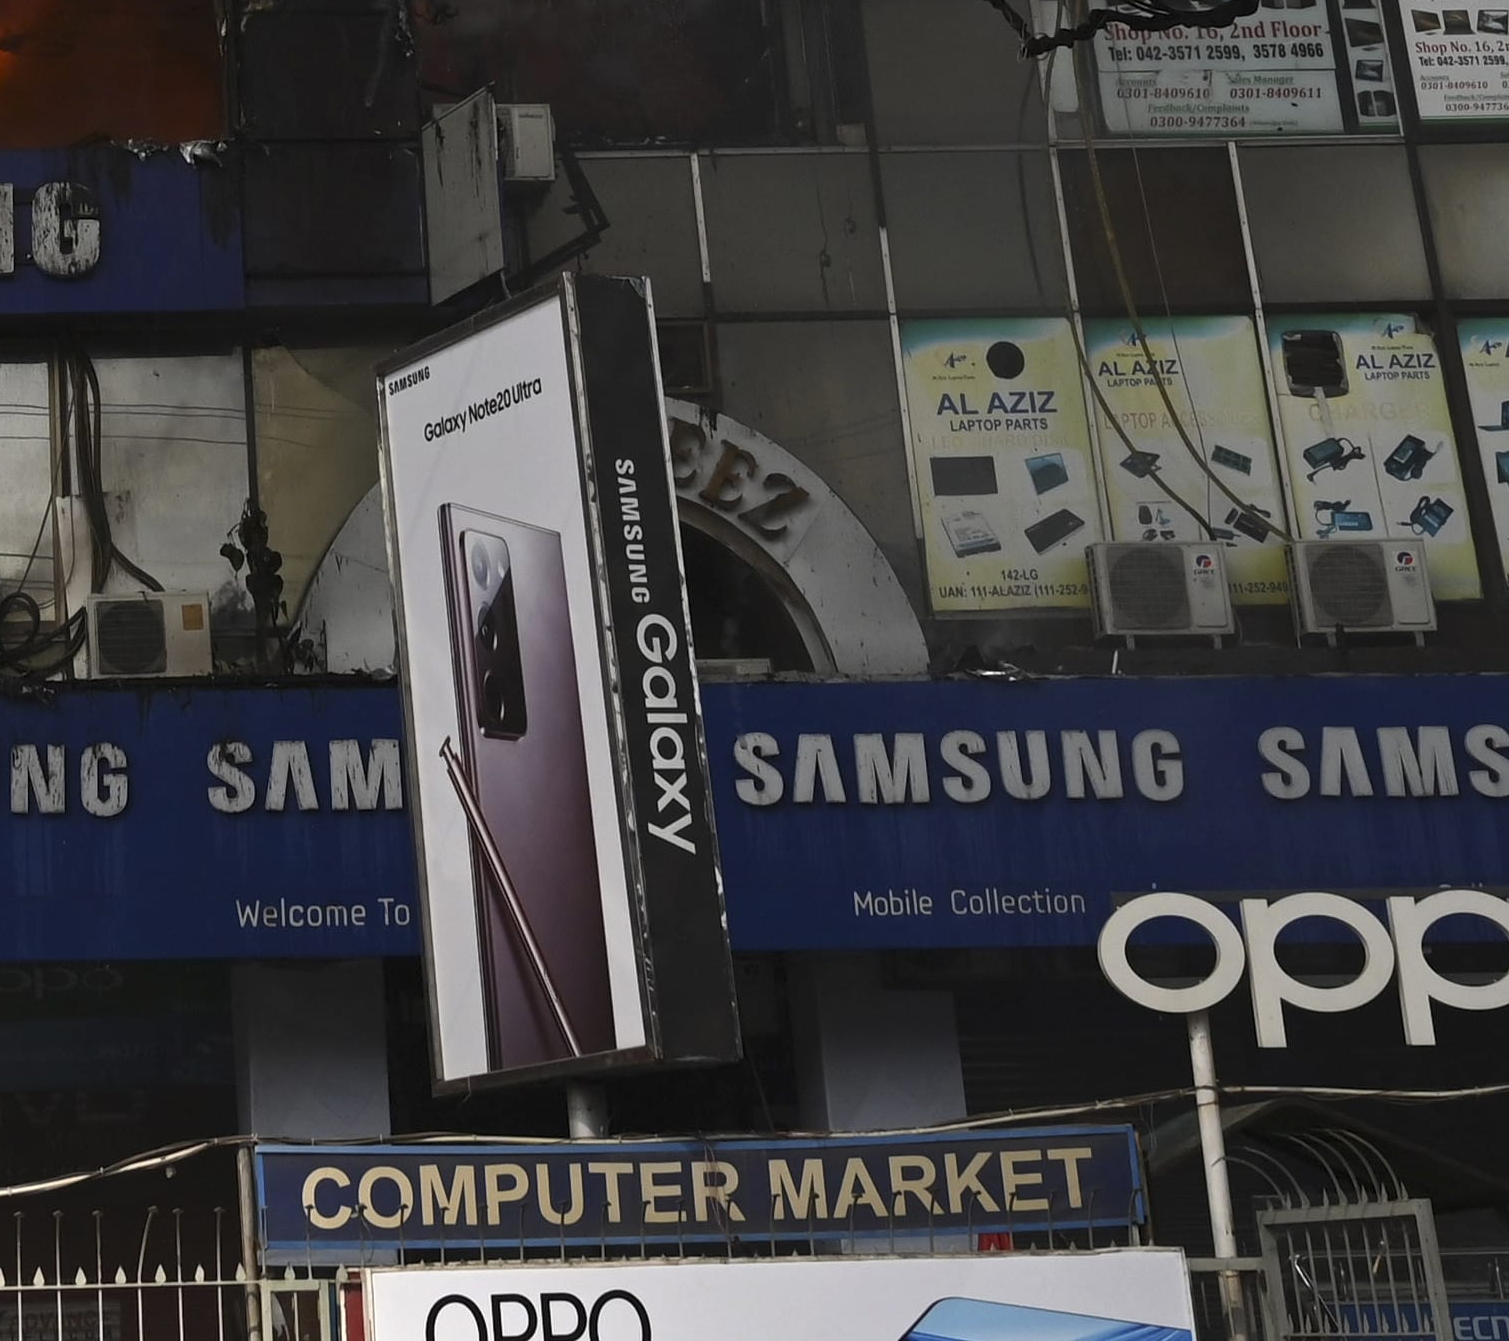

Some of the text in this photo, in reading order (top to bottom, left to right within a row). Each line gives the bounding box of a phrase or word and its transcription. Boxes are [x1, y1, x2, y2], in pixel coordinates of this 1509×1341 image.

[1230, 21, 1265, 39] 2nd
[1272, 20, 1322, 38] Floor
[1108, 43, 1324, 62] Tel: 042-3571 2599, 3578 4966
[1415, 41, 1448, 56] Shop
[1450, 41, 1472, 52] No.
[1476, 40, 1495, 54] 16,
[1419, 56, 1435, 67] Tel:
[1437, 55, 1480, 66] 042-3571
[1229, 87, 1322, 99] 0301-8409611
[1098, 359, 1179, 377] AL AZIZ
[1356, 353, 1436, 370] AL AZIZ
[388, 365, 431, 397] SAMSUNG
[1107, 378, 1143, 388] LAPTOP
[1364, 371, 1431, 381] LAPTOP PARTS
[423, 375, 543, 443] Galaxy Note20 Ultra
[937, 390, 1058, 416] AL AZIZ
[950, 417, 1048, 432] LAPTOP PARTS
[1000, 569, 1040, 583] 142-LG
[938, 583, 1033, 599] UAN: 111-ALAZIZ
[613, 458, 700, 855] SAMSUNG Galaxy
[734, 728, 1187, 807] SAMSUNG
[853, 886, 1087, 918] Mobile Collection
[234, 896, 411, 930] Welcome To
[301, 1146, 1094, 1231] COMPUTER MARKET
